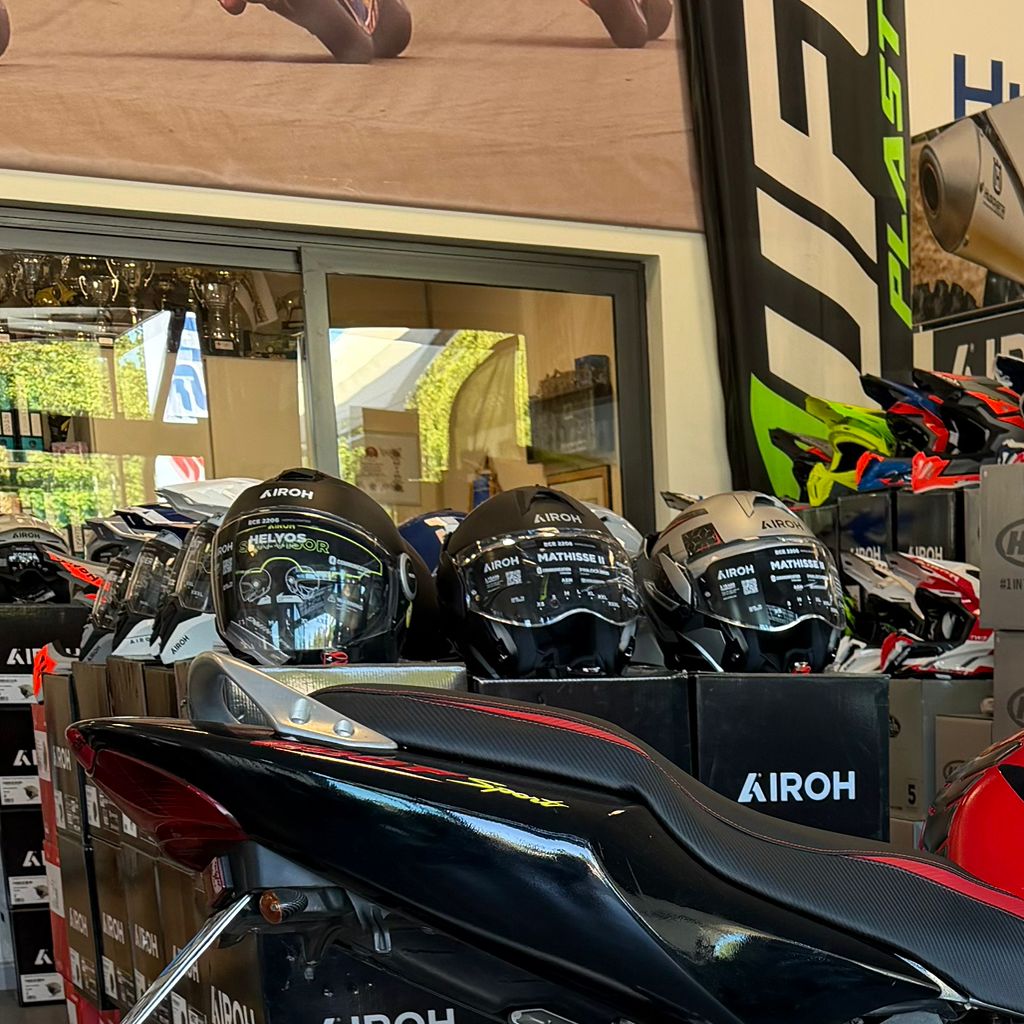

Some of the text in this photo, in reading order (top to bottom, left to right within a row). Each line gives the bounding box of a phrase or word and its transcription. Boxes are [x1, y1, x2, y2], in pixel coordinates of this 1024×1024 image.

[259, 487, 314, 500] AIROH
[534, 512, 582, 524] AIROH
[761, 519, 804, 531] AIROH
[248, 533, 307, 544] HELYOS
[537, 552, 597, 563] MATHISSE
[484, 556, 520, 573] AIROH
[770, 560, 819, 571] MATHISSE
[717, 564, 755, 581] AIROH
[1000, 579, 1011, 590] #1
[1012, 579, 1022, 590] IN
[130, 637, 152, 645] AIRO
[171, 635, 190, 655] AIROH
[738, 771, 856, 804] AIROH
[907, 784, 916, 805] 5
